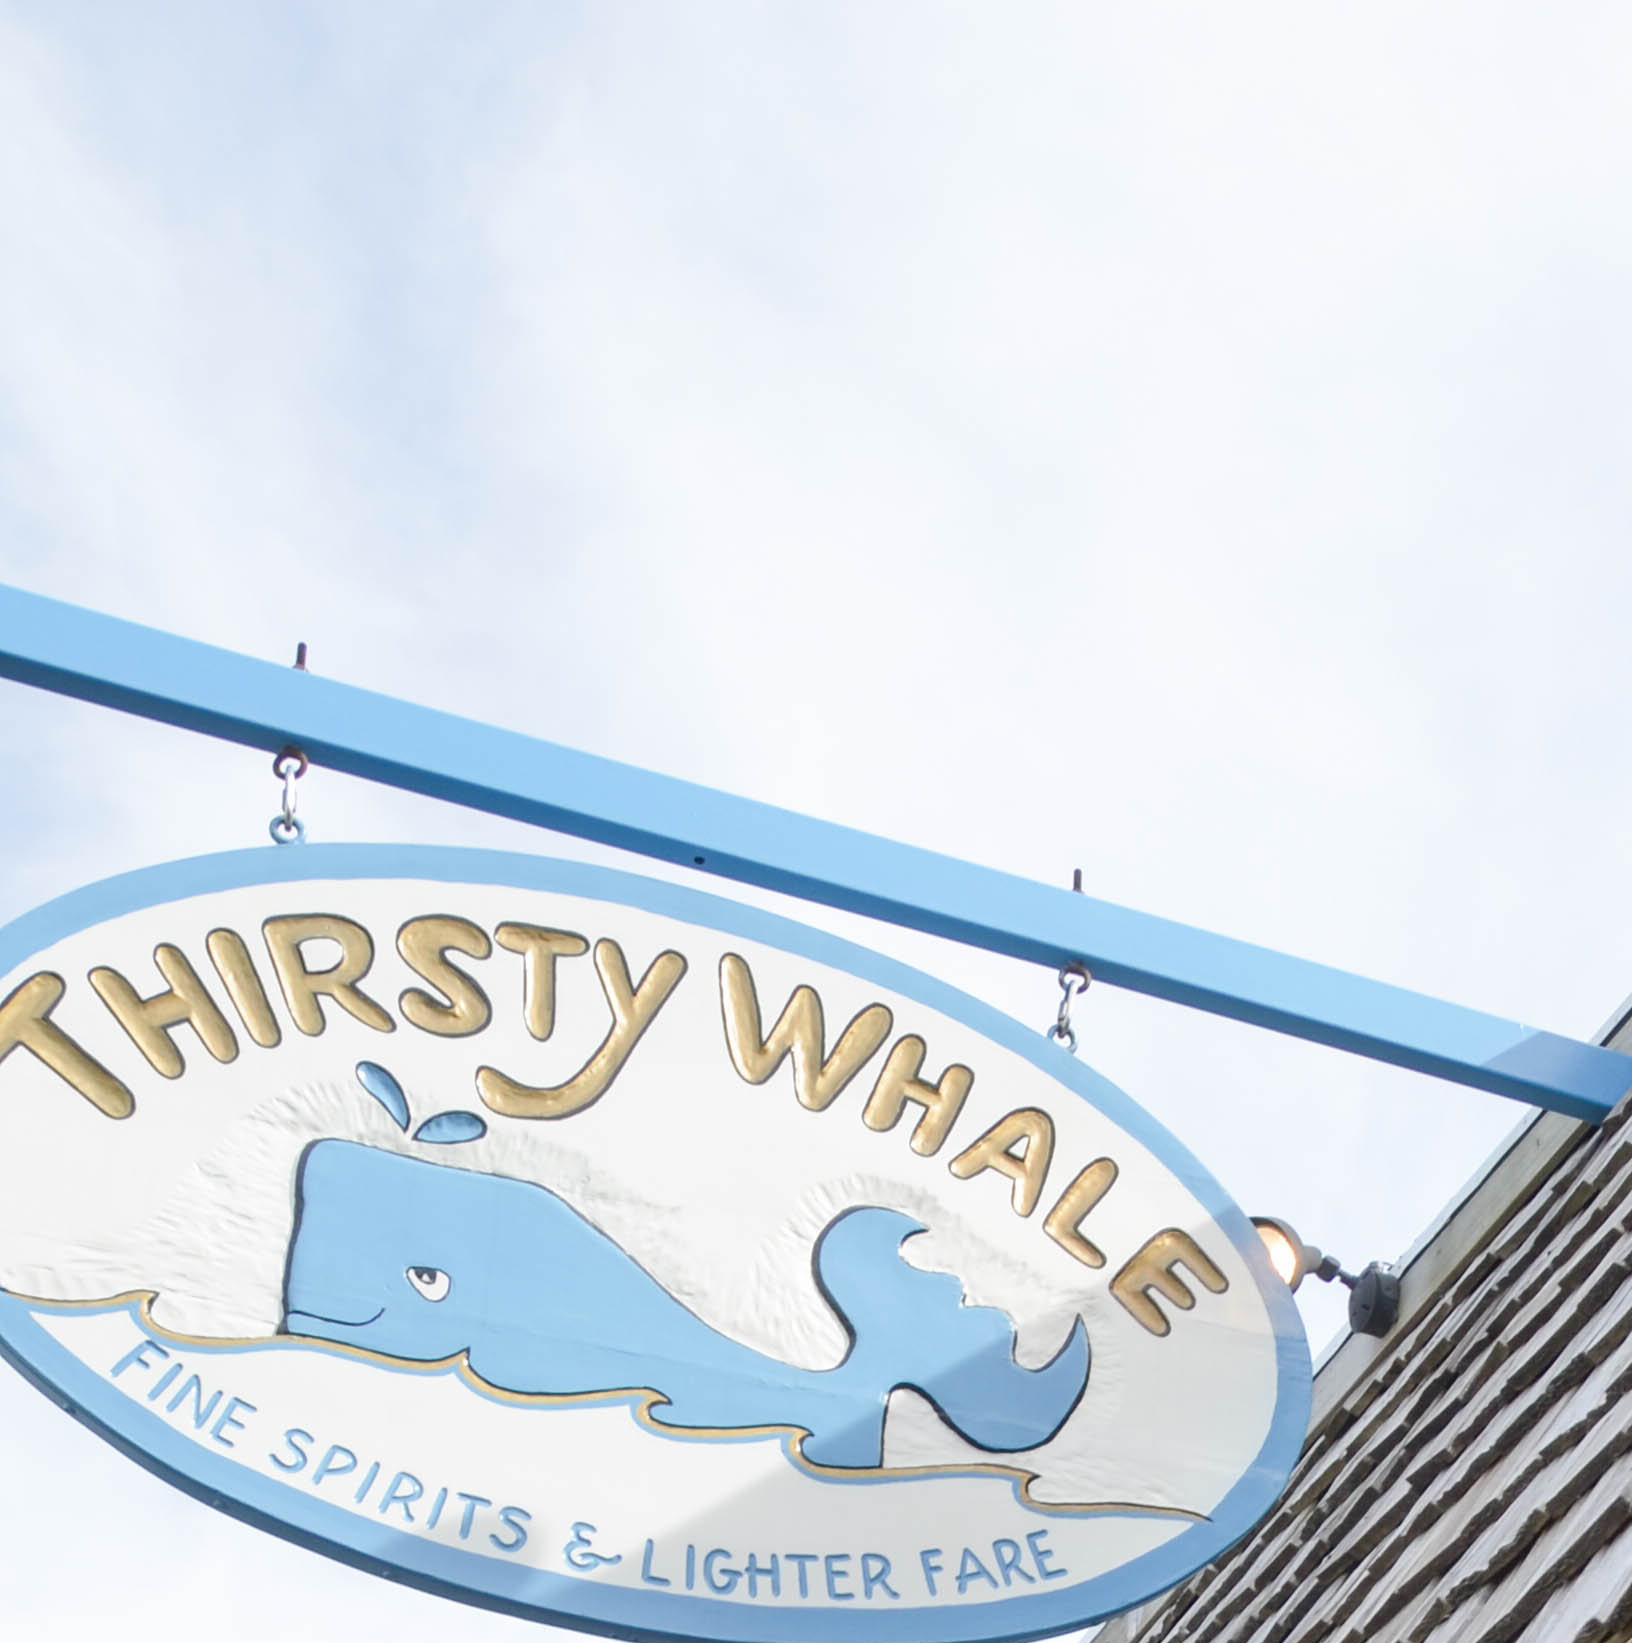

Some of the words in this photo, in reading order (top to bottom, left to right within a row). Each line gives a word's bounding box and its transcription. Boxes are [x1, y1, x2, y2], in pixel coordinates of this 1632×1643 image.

[0, 912, 688, 1119] THIRSTY
[718, 952, 1228, 1338] WHALE
[111, 1339, 258, 1448] FINE
[268, 1428, 533, 1554] SPIRITS
[562, 1521, 623, 1573] &
[640, 1538, 901, 1601] LIGHTER
[918, 1528, 1068, 1595] FARE
